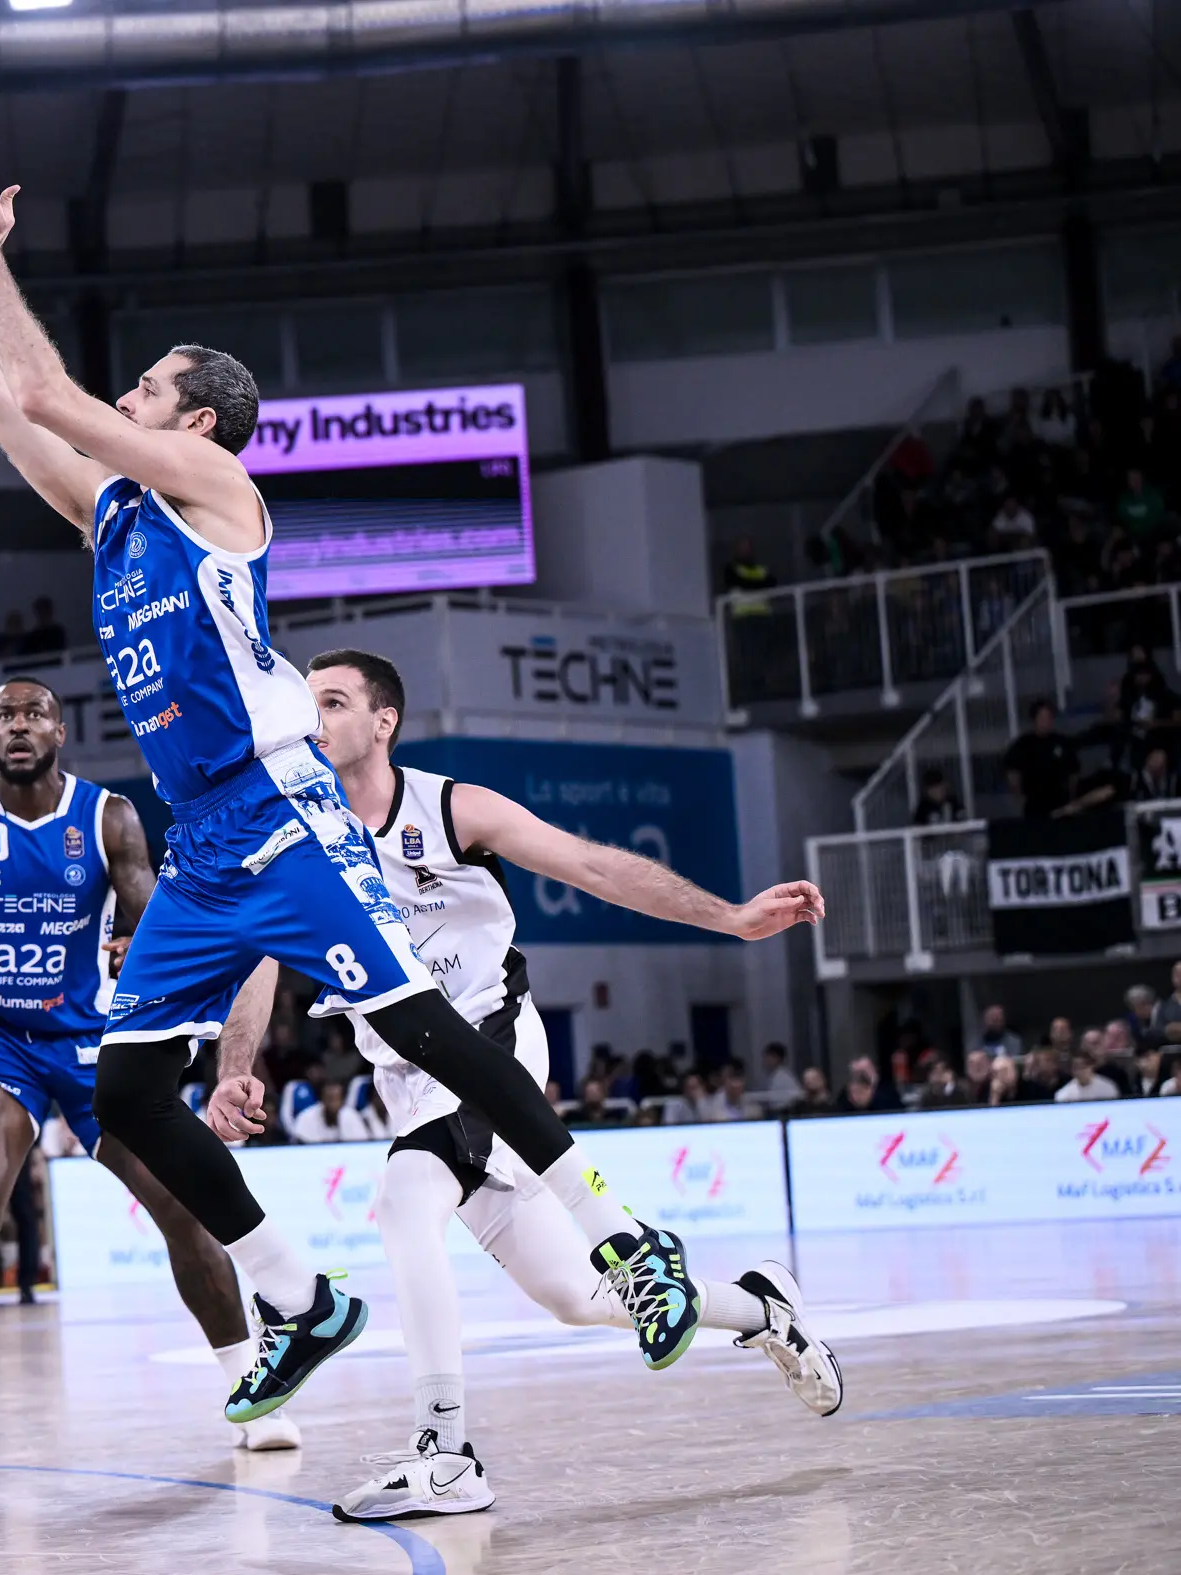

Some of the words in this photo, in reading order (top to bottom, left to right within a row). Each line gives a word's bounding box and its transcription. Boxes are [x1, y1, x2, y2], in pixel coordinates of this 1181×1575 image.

[310, 397, 515, 442] Industries
[128, 590, 190, 632] MEGRANI
[130, 677, 164, 703] COMPANY
[404, 837, 421, 845] LBA
[418, 881, 444, 896] DERTHONA
[997, 857, 1123, 899] TORTONA
[413, 900, 446, 917] ASTM
[325, 943, 369, 990] 8
[16, 975, 64, 986] COMPANY
